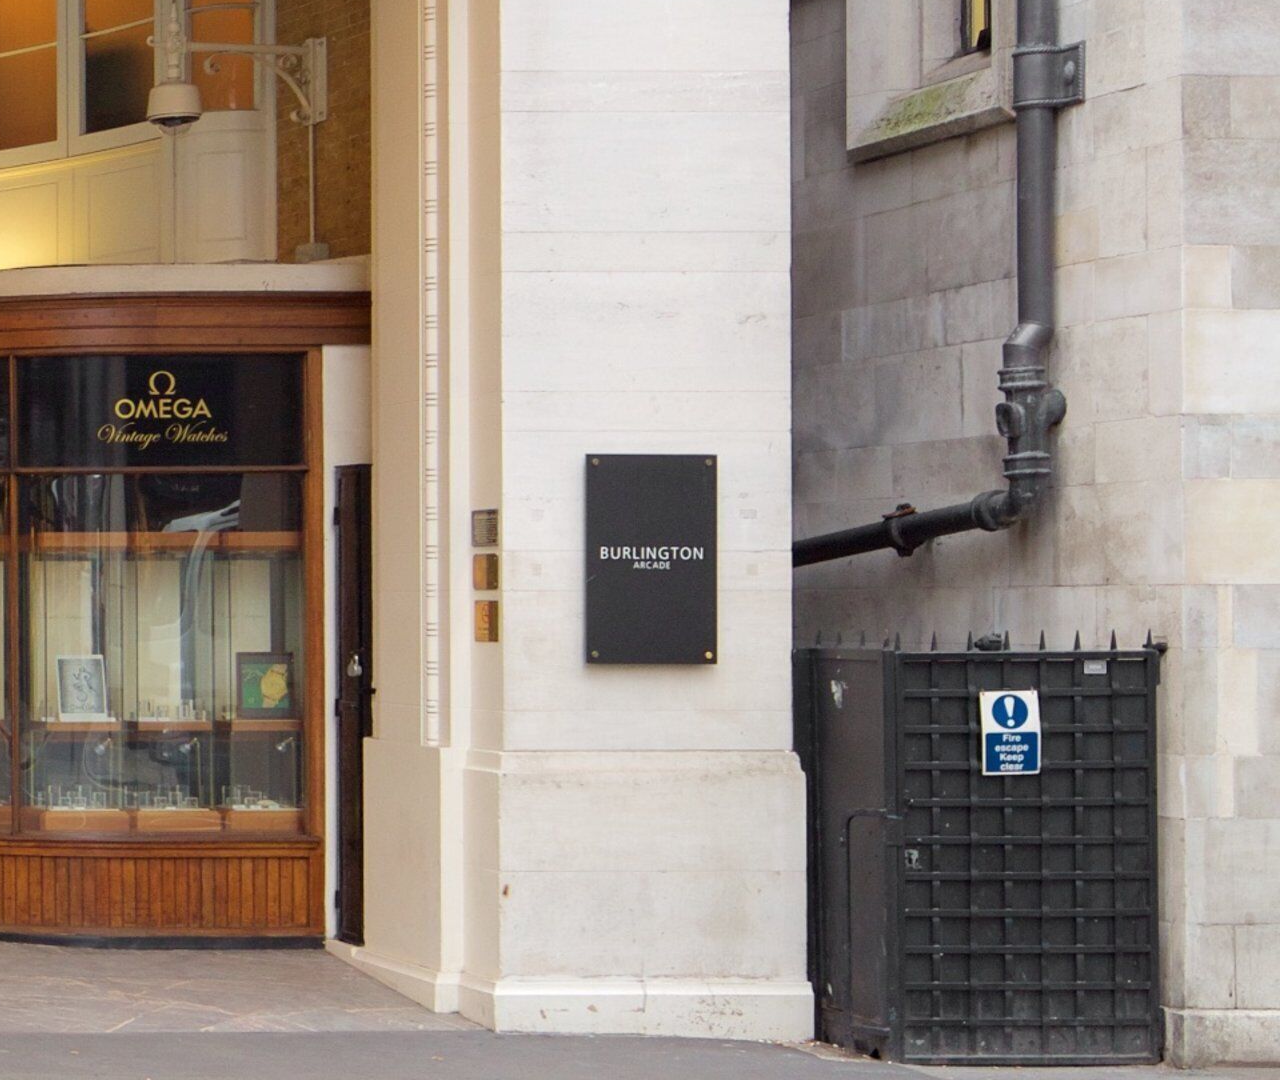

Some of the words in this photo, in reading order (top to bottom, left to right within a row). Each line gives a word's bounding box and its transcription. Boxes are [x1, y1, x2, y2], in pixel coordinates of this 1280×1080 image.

[114, 398, 212, 419] OMEGA
[97, 422, 160, 451] Vintage
[165, 420, 228, 444] Watches
[600, 546, 704, 560] BURLINGTON
[633, 561, 671, 569] ARCADE
[1002, 734, 1021, 742] Fire
[994, 744, 1029, 753] escape
[1000, 753, 1024, 762] Keep
